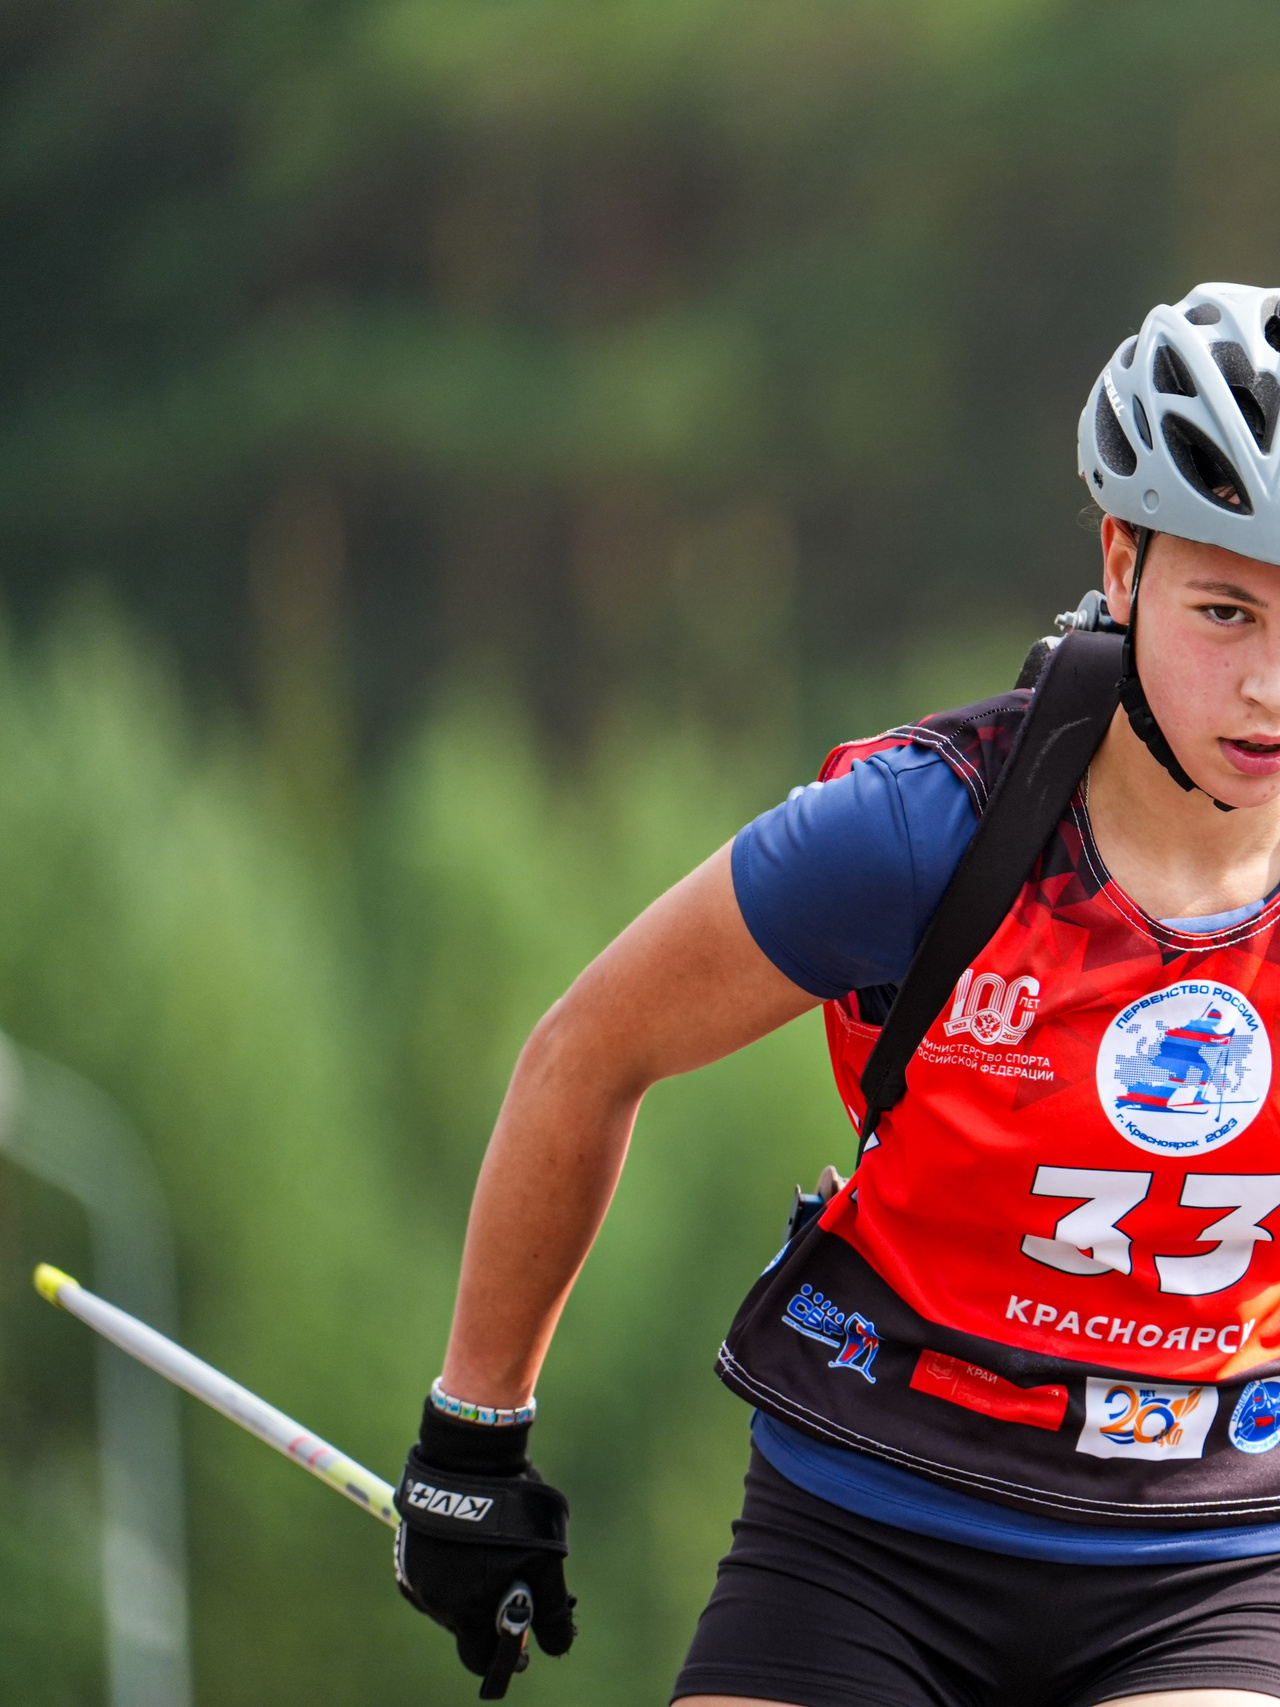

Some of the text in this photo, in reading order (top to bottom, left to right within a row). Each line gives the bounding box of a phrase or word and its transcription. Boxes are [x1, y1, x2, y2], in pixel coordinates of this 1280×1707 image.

[1018, 996, 1041, 1009] ЛЕТ
[1115, 984, 1259, 1032] ПЕРВЕНСТВО РОССИИ
[918, 1046, 1055, 1081] ОССИЙСКОЙ ФЕДЕРАЦИИ
[1005, 1053, 1050, 1067] СПОРТА
[1125, 1121, 1199, 1150] Красноярск
[1205, 1117, 1238, 1143] 2023
[1099, 1384, 1175, 1445] 20 ЛЕТ
[409, 1483, 493, 1520] KV+
